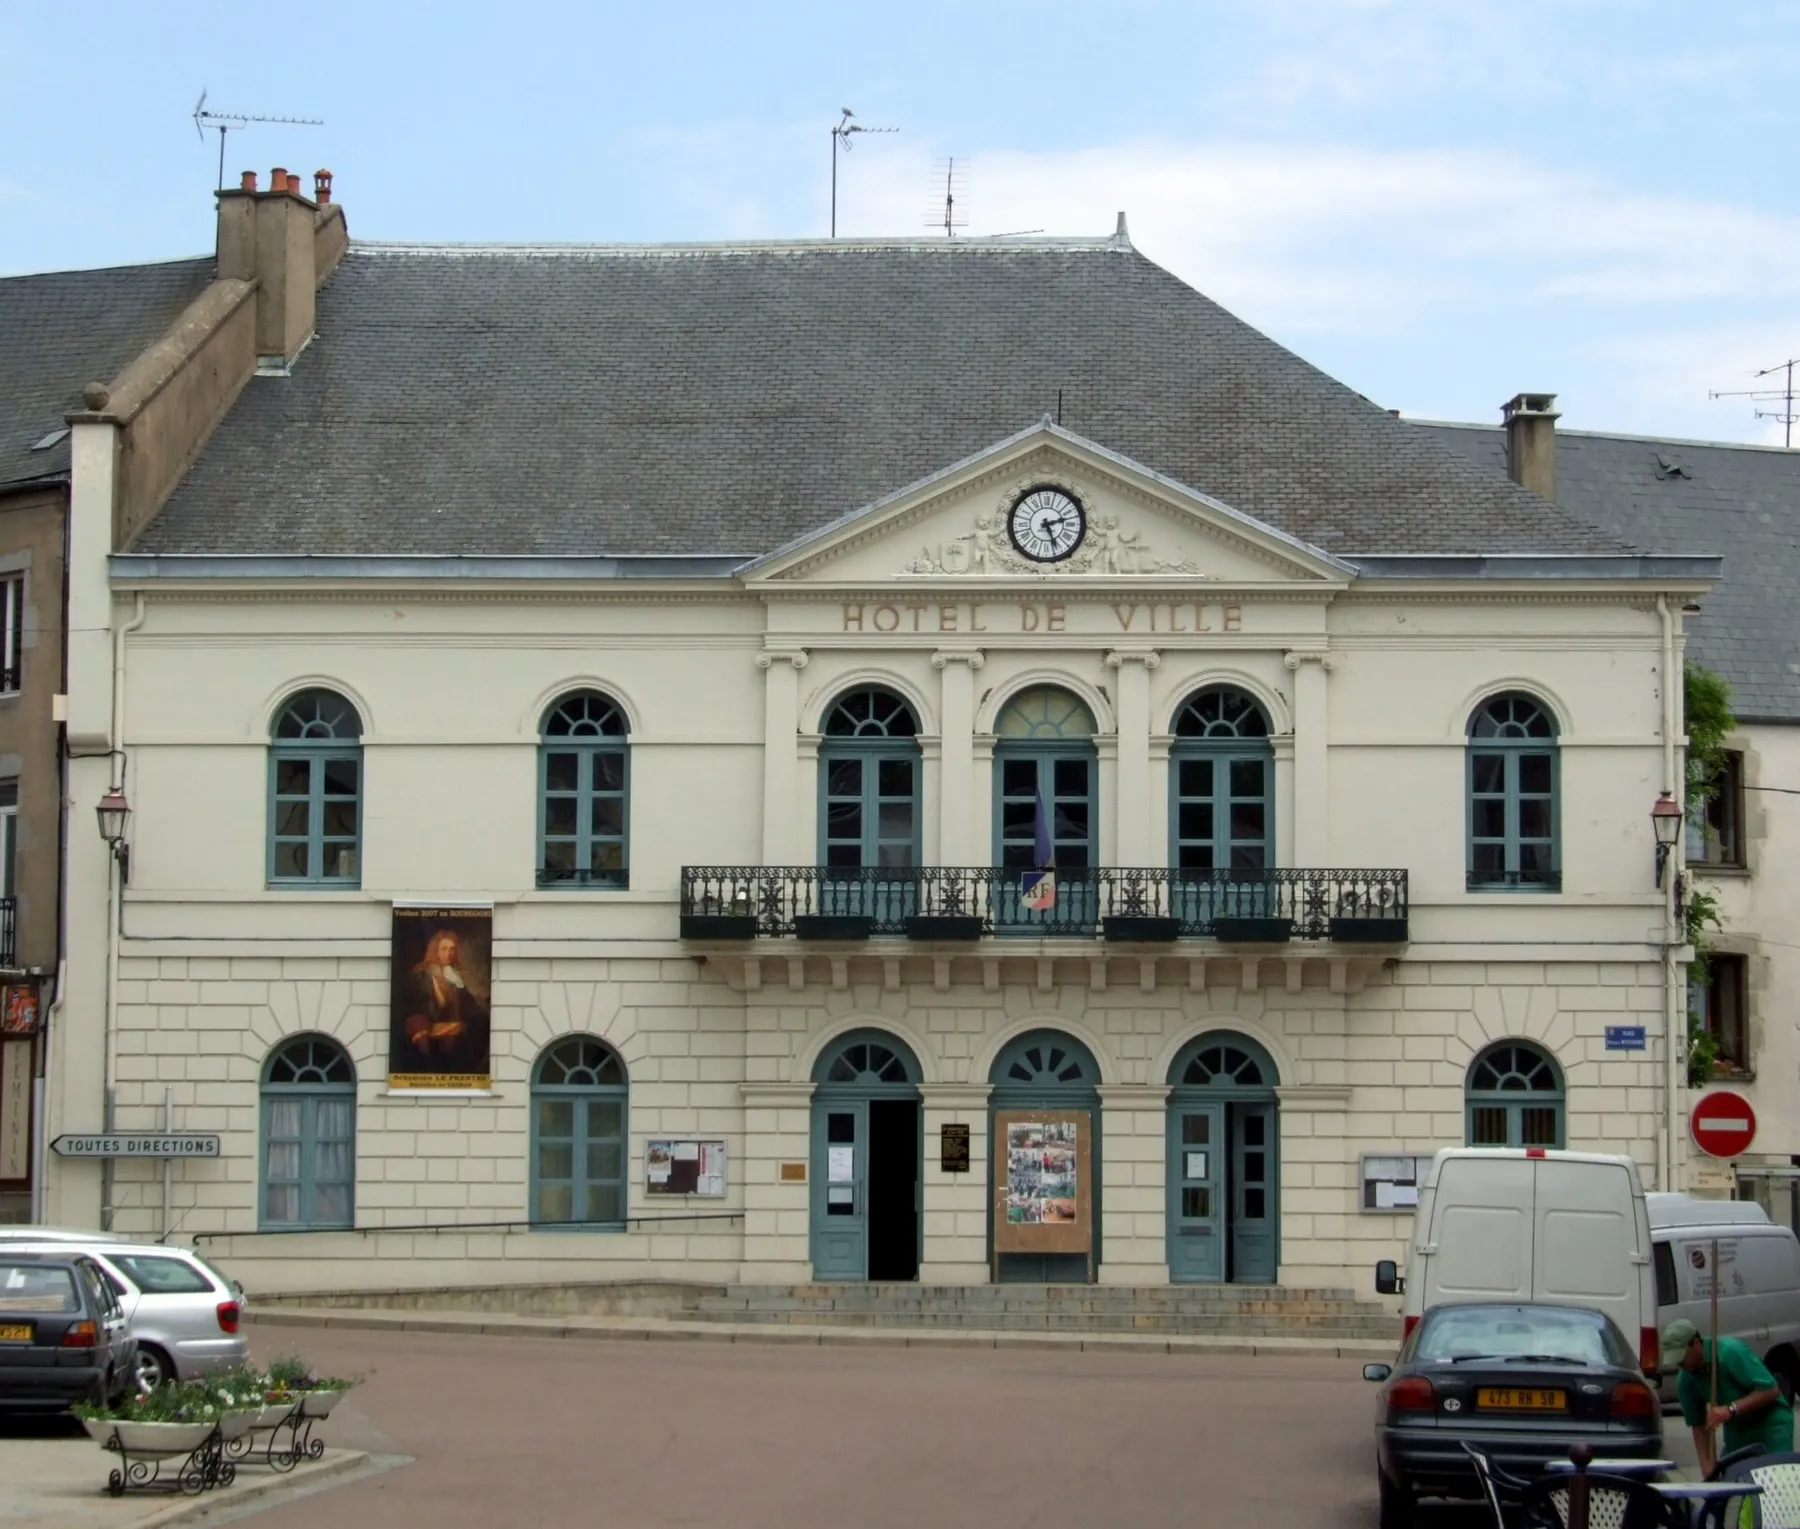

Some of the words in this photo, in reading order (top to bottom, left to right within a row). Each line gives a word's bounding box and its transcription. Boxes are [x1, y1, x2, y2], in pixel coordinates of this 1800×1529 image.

[841, 603, 987, 632] HOTEL
[1019, 603, 1066, 632] DE
[1110, 603, 1242, 632] VILLE
[67, 1140, 120, 1152] TOUTES
[127, 1140, 214, 1152] DIRECTIONS
[1488, 1390, 1511, 1406] 473
